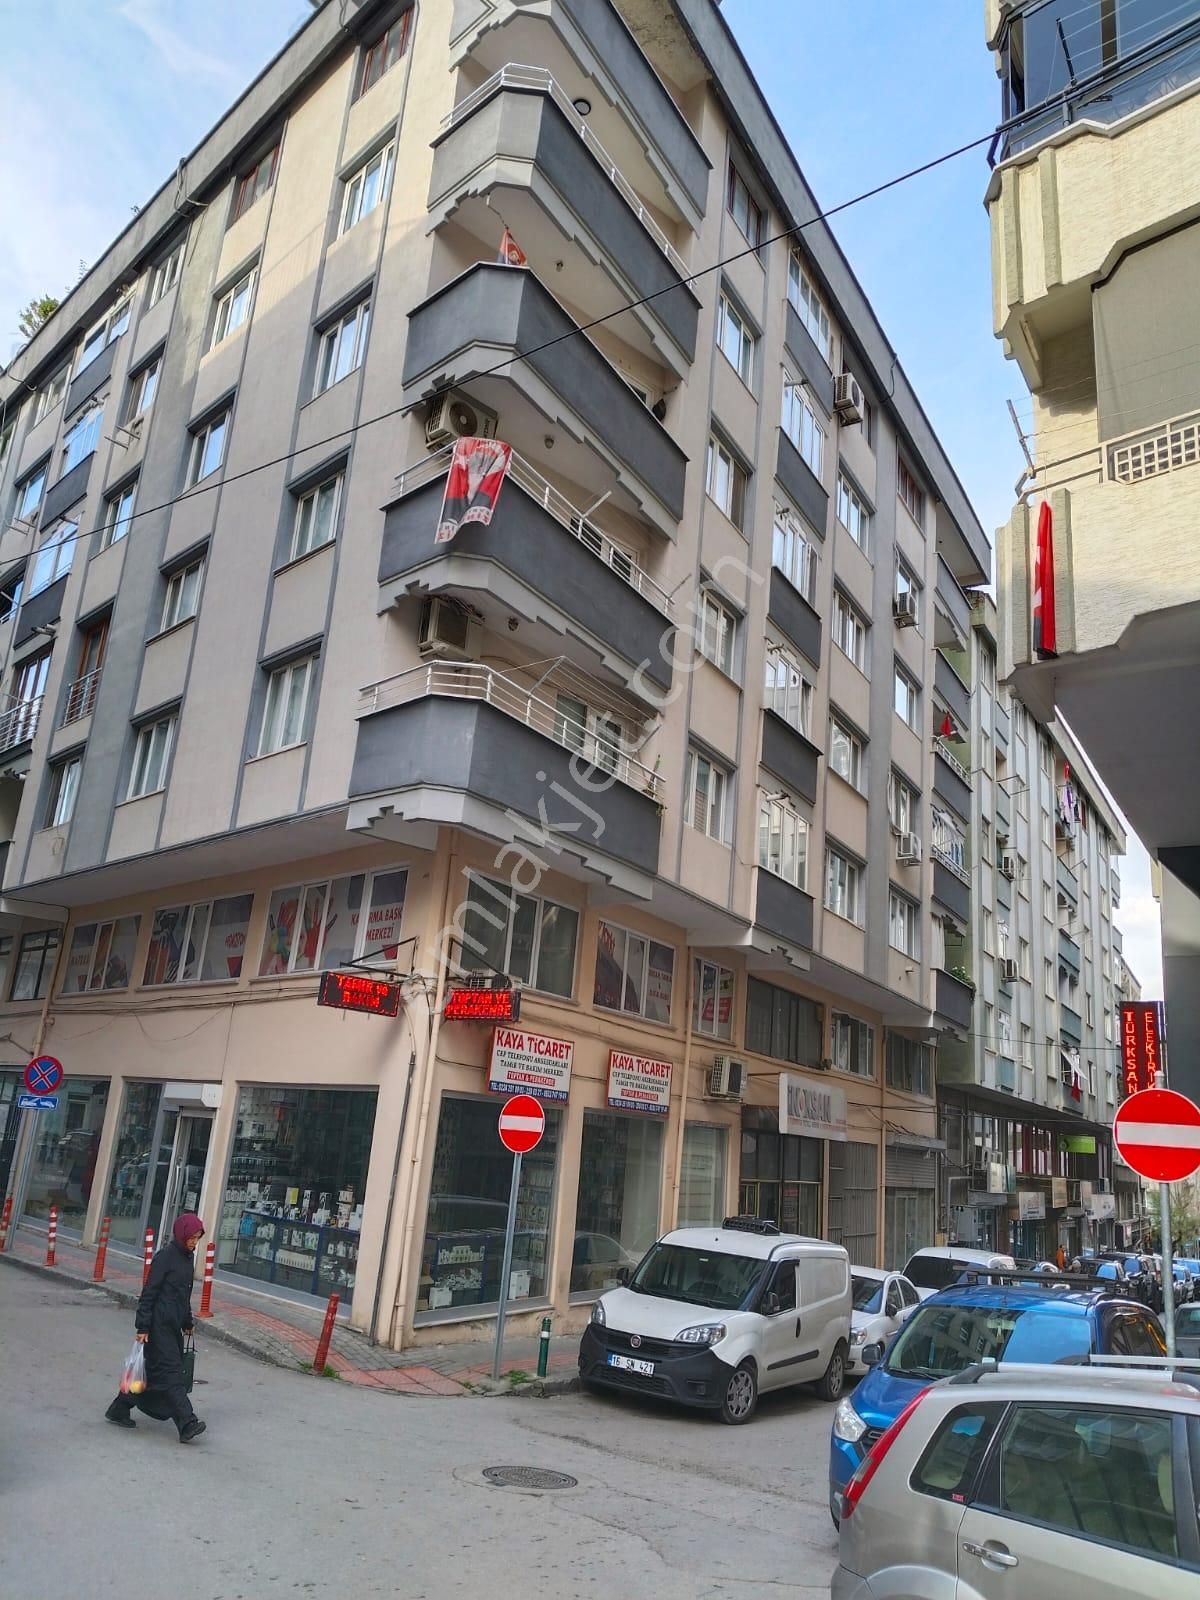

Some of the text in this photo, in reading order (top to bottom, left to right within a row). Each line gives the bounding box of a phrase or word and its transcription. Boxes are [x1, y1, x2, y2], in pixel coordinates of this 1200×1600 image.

[496, 993, 510, 1004] VE
[497, 1029, 524, 1051] KAYA
[508, 1052, 534, 1063] TELEFONU
[612, 1054, 634, 1071] KAYA
[614, 1355, 621, 1366] 16
[640, 1361, 653, 1374] 421
